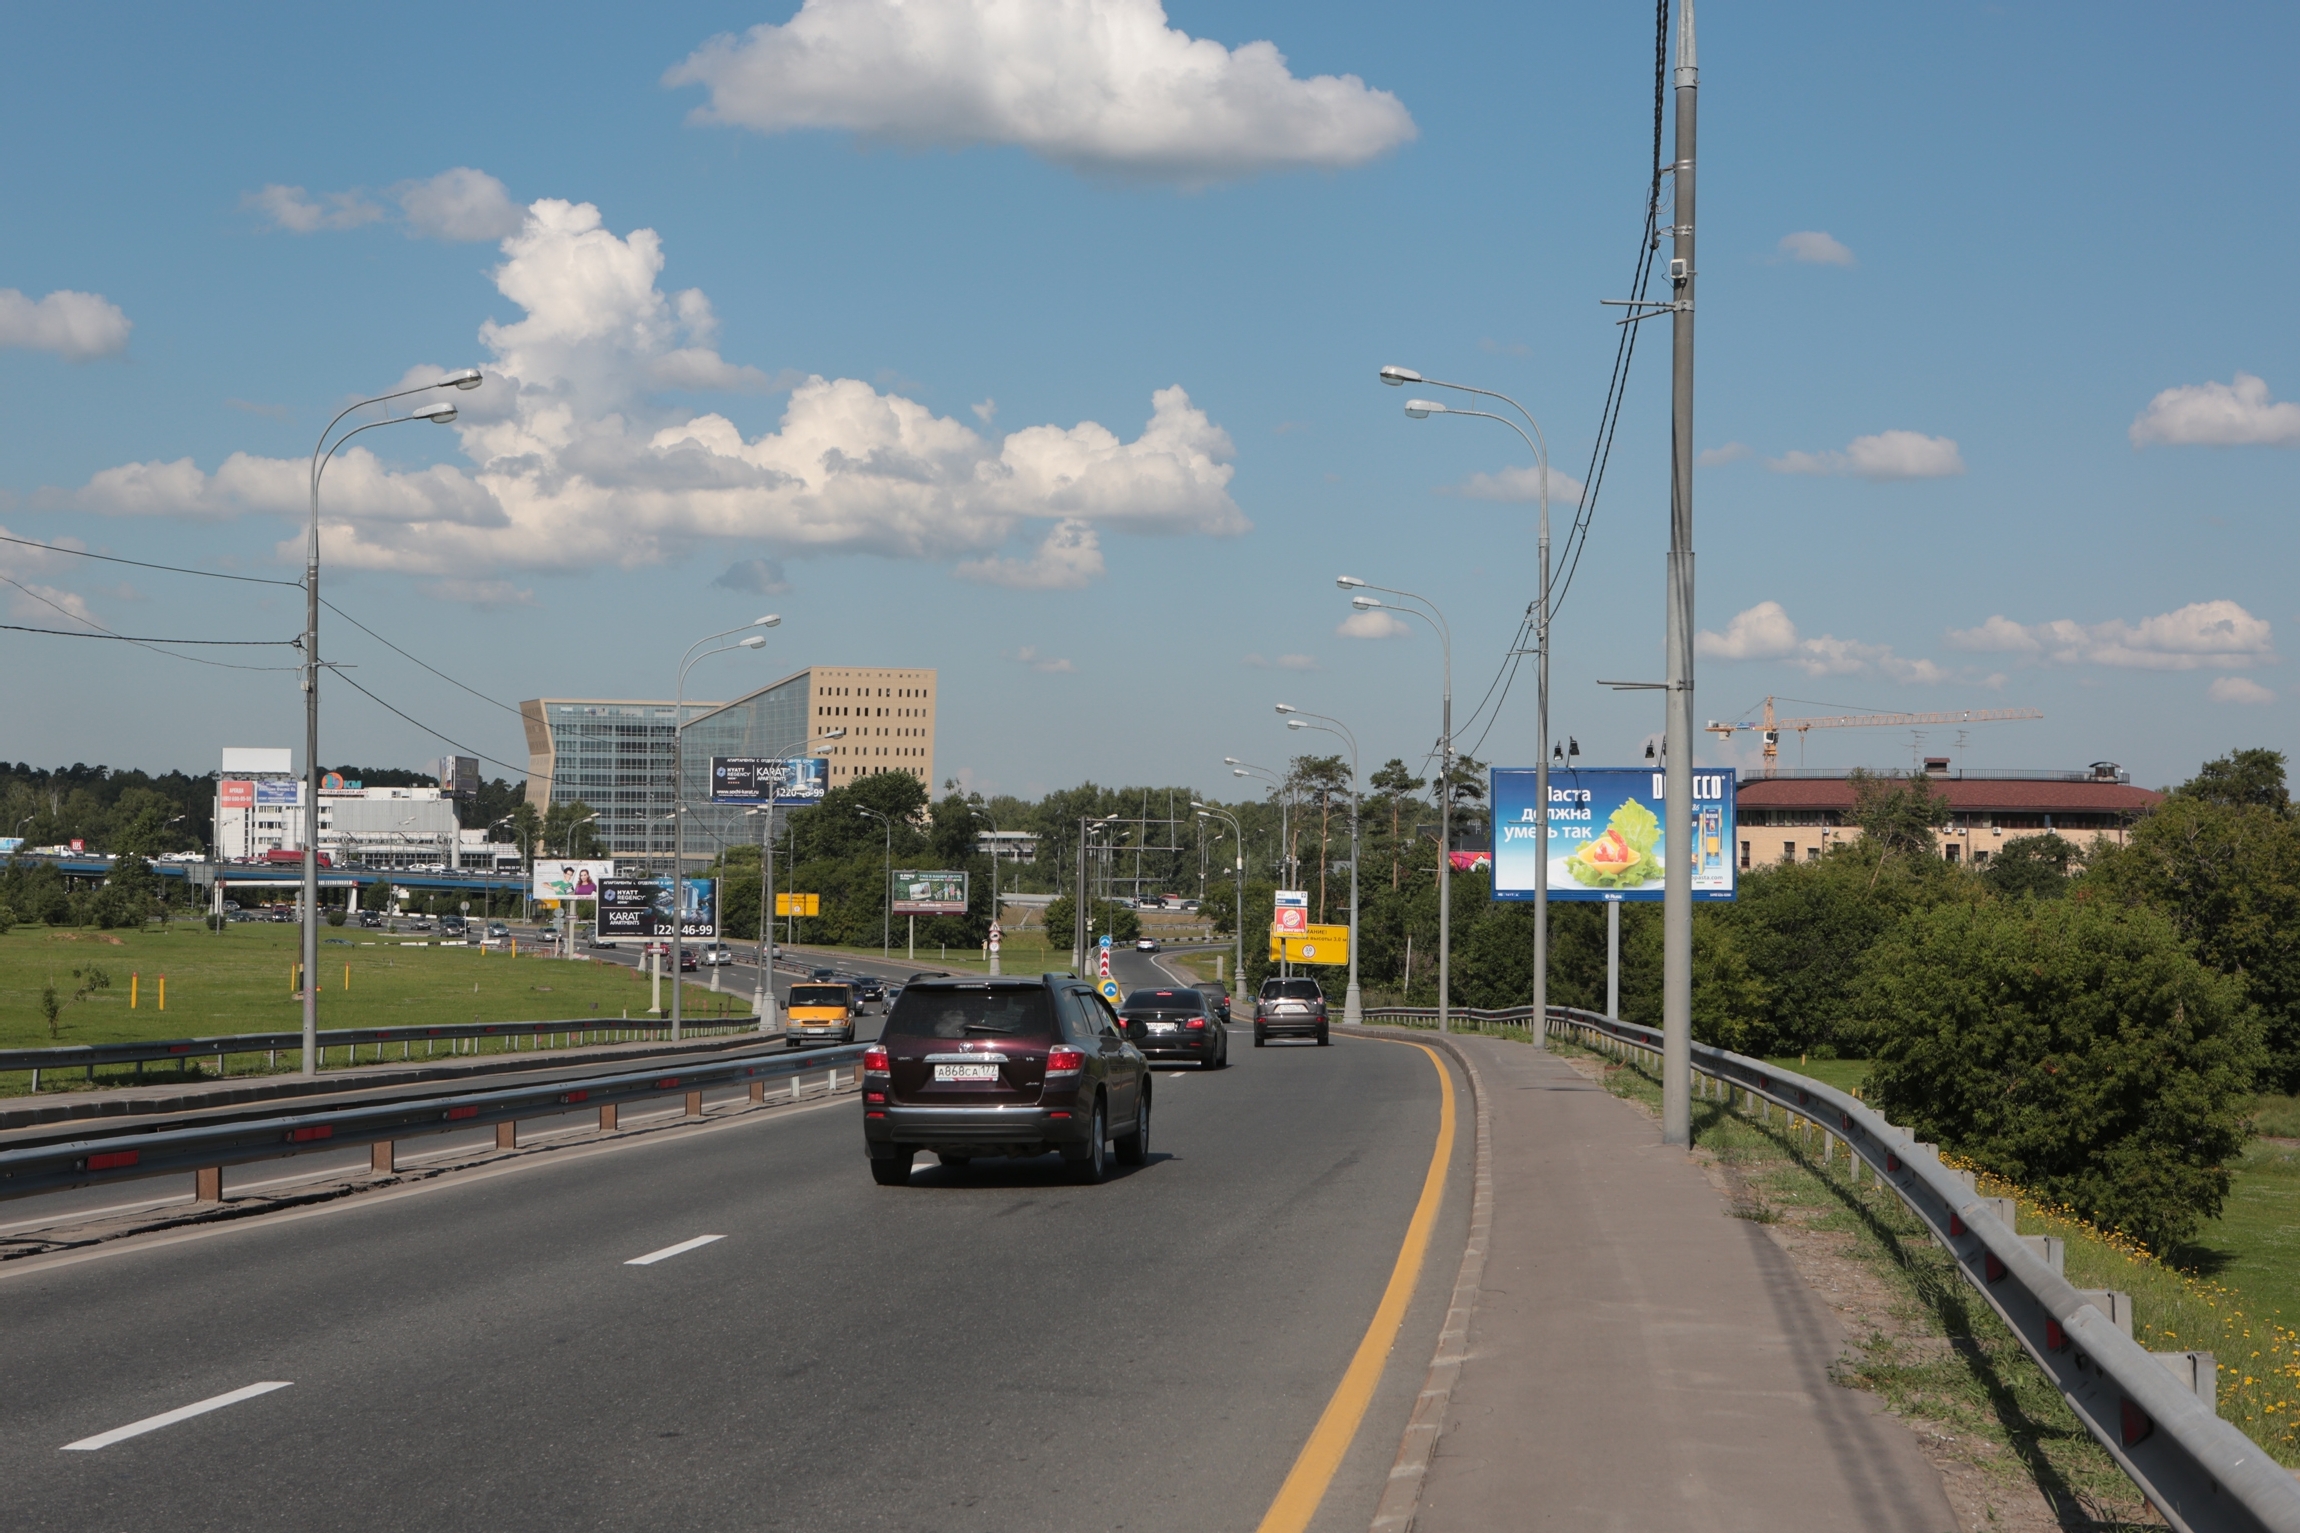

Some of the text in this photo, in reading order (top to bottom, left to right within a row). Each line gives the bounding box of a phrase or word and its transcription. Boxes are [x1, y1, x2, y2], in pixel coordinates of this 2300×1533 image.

[1503, 826, 1592, 843] умеь так
[609, 912, 640, 921] KARAT
[981, 1065, 996, 1074] 177
